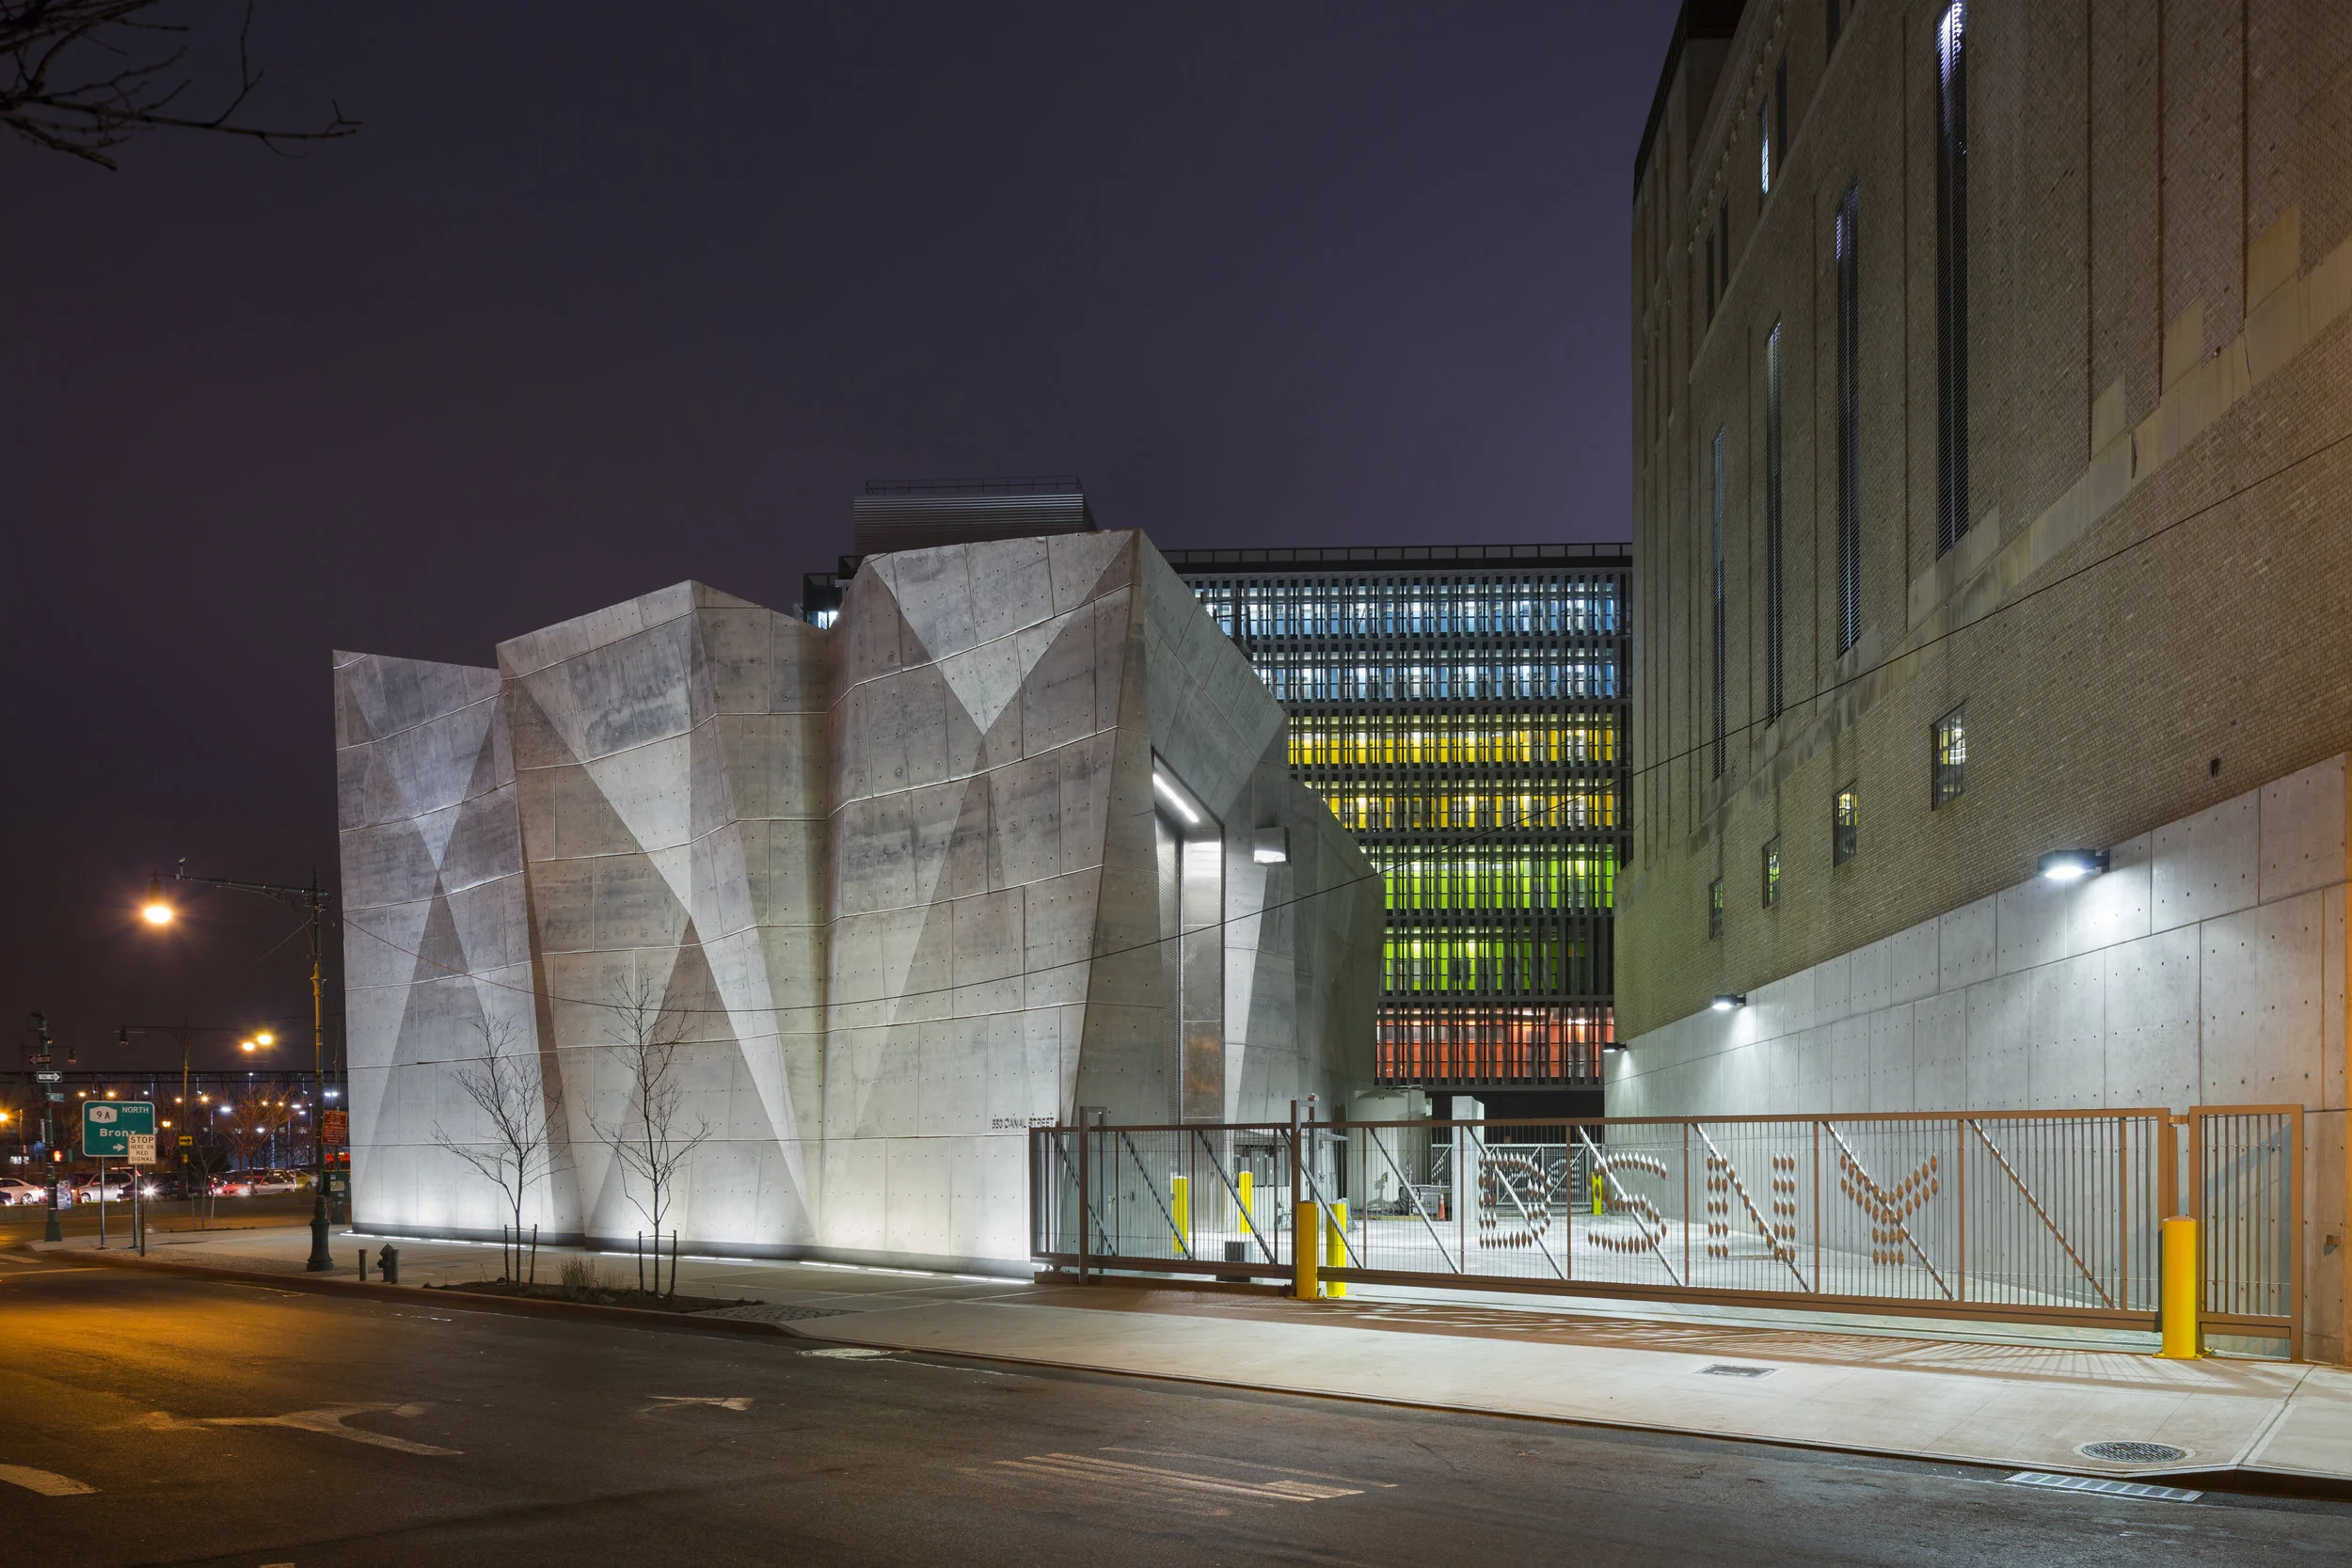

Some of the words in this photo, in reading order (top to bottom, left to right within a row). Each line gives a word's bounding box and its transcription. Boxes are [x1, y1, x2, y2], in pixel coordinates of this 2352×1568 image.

[1005, 1117, 1026, 1129] CANAL
[1028, 1117, 1054, 1128] STREET
[1478, 1150, 1936, 1268] DSNY
